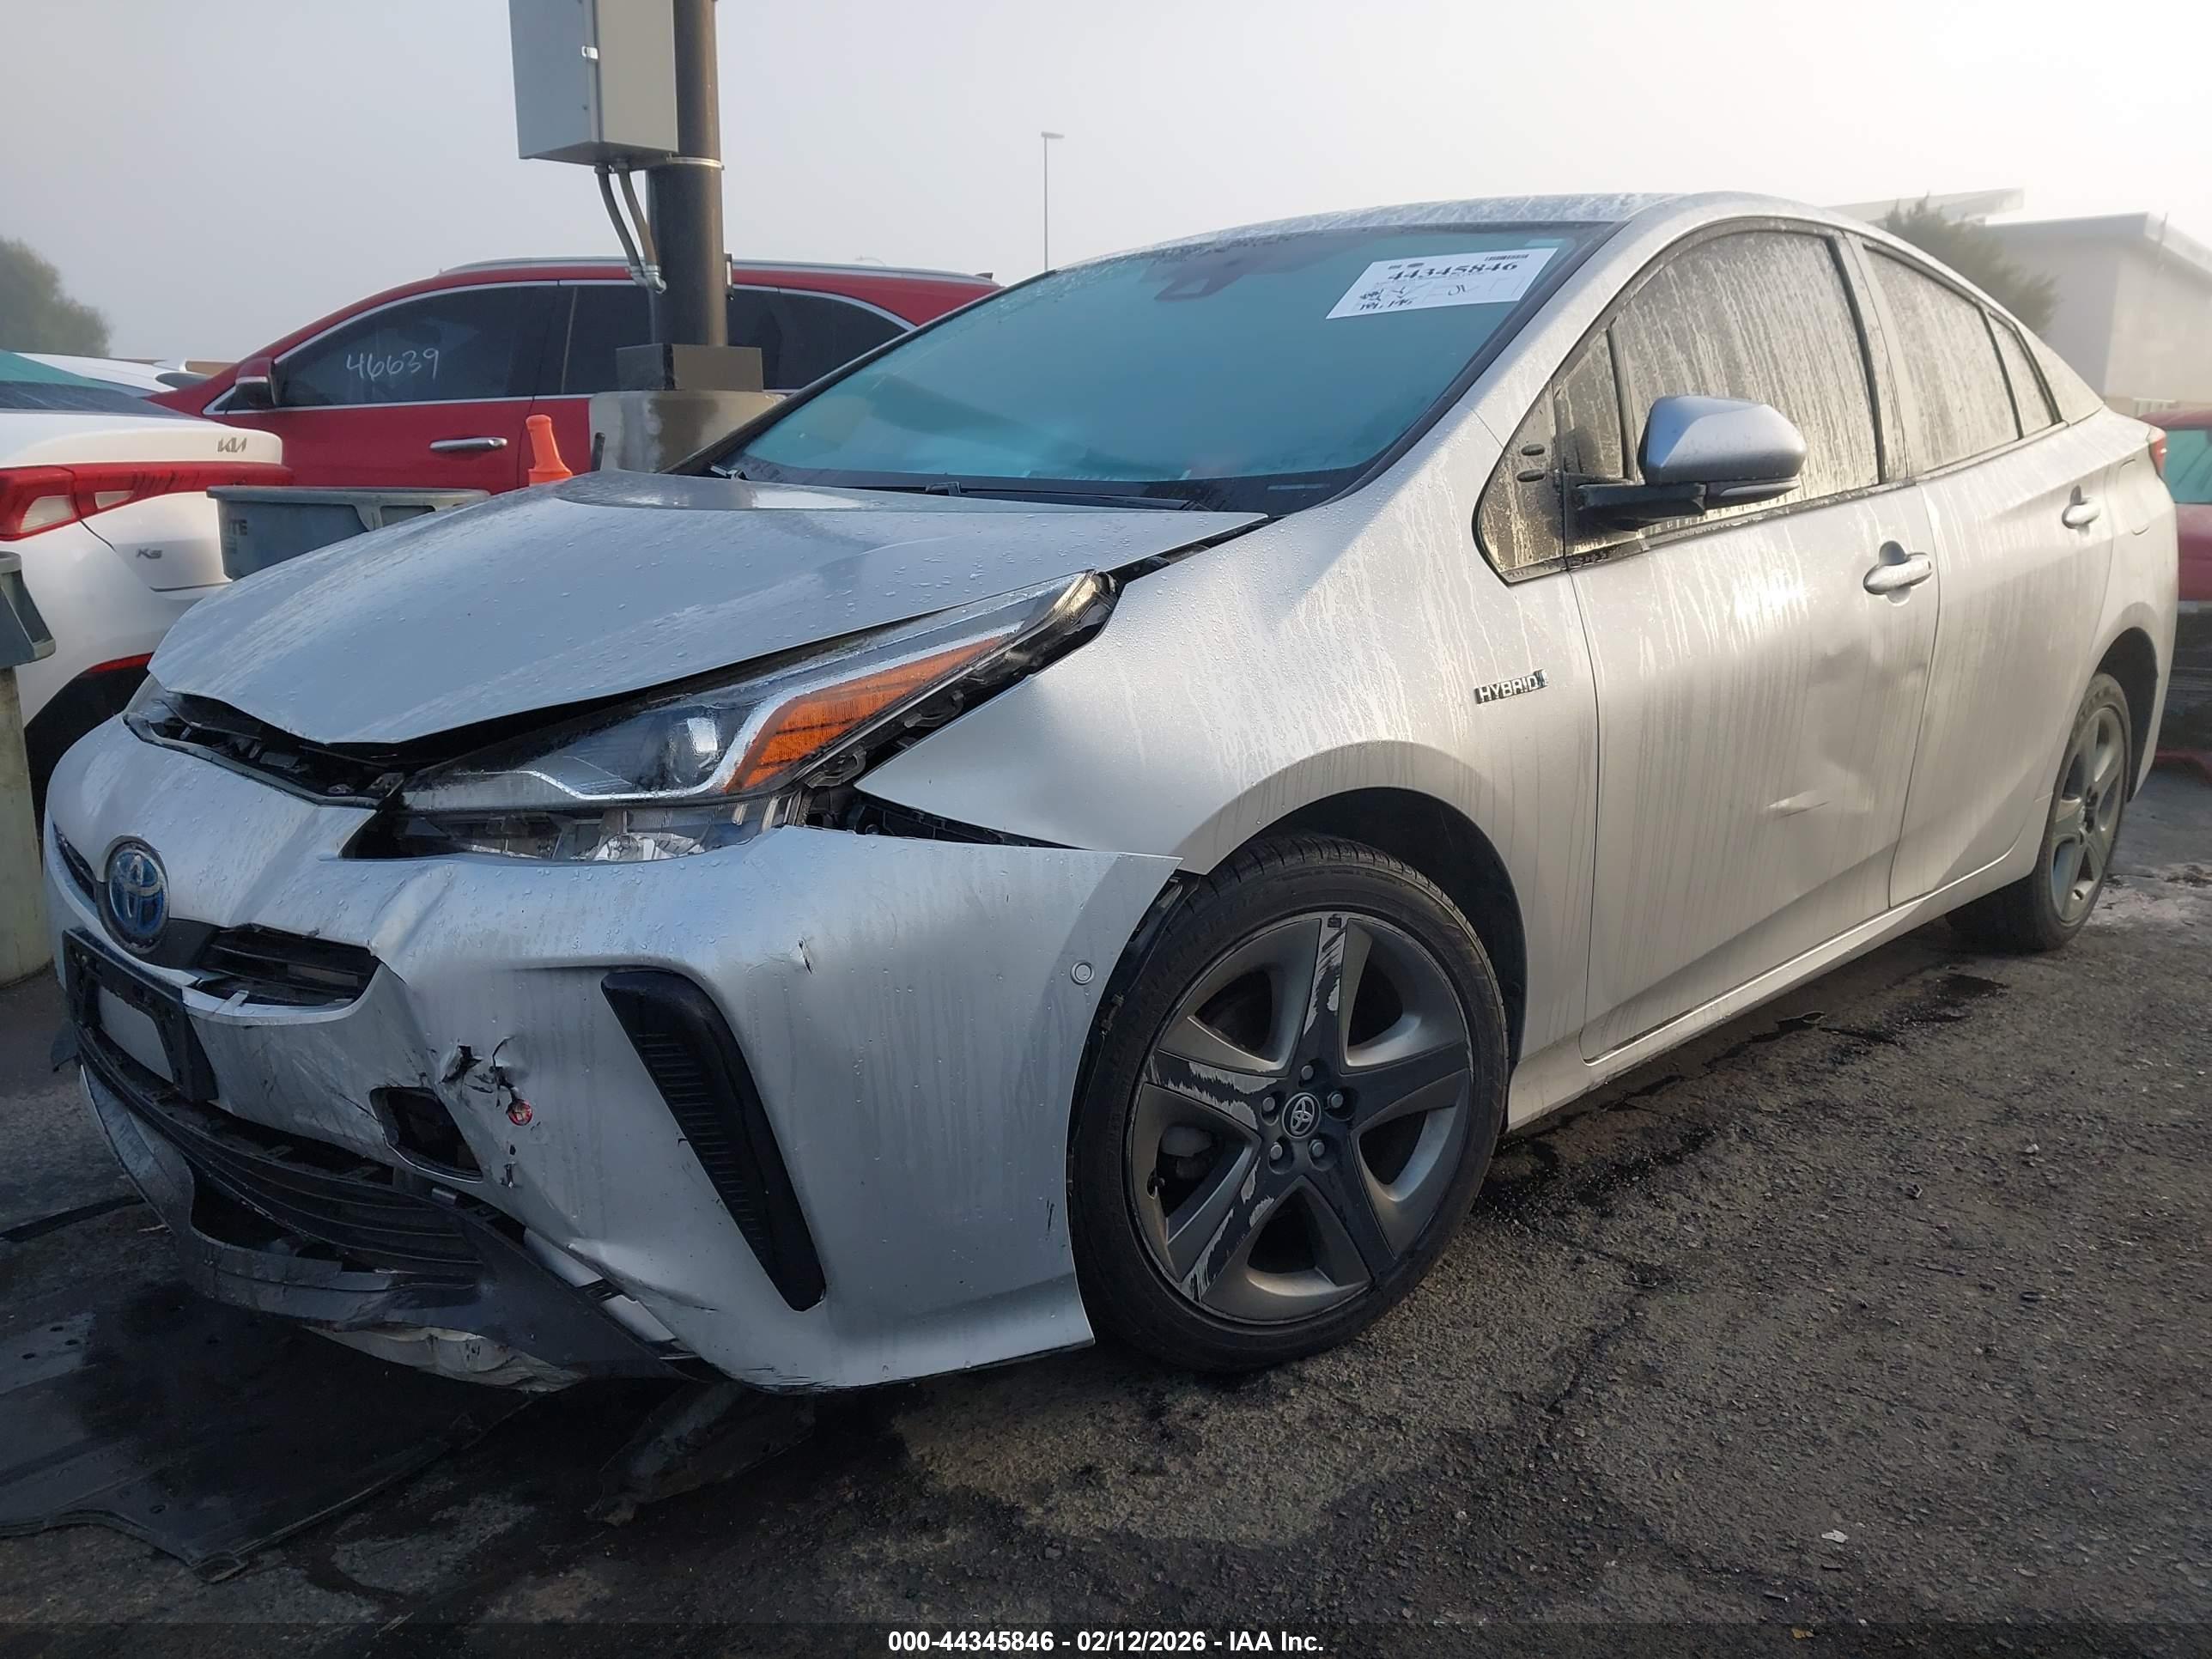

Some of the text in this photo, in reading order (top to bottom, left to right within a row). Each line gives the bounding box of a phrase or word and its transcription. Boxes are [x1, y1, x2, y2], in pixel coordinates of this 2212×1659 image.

[1388, 261, 1518, 281] 44345846
[346, 348, 439, 380] 46639
[1478, 674, 1540, 702] HYBRID
